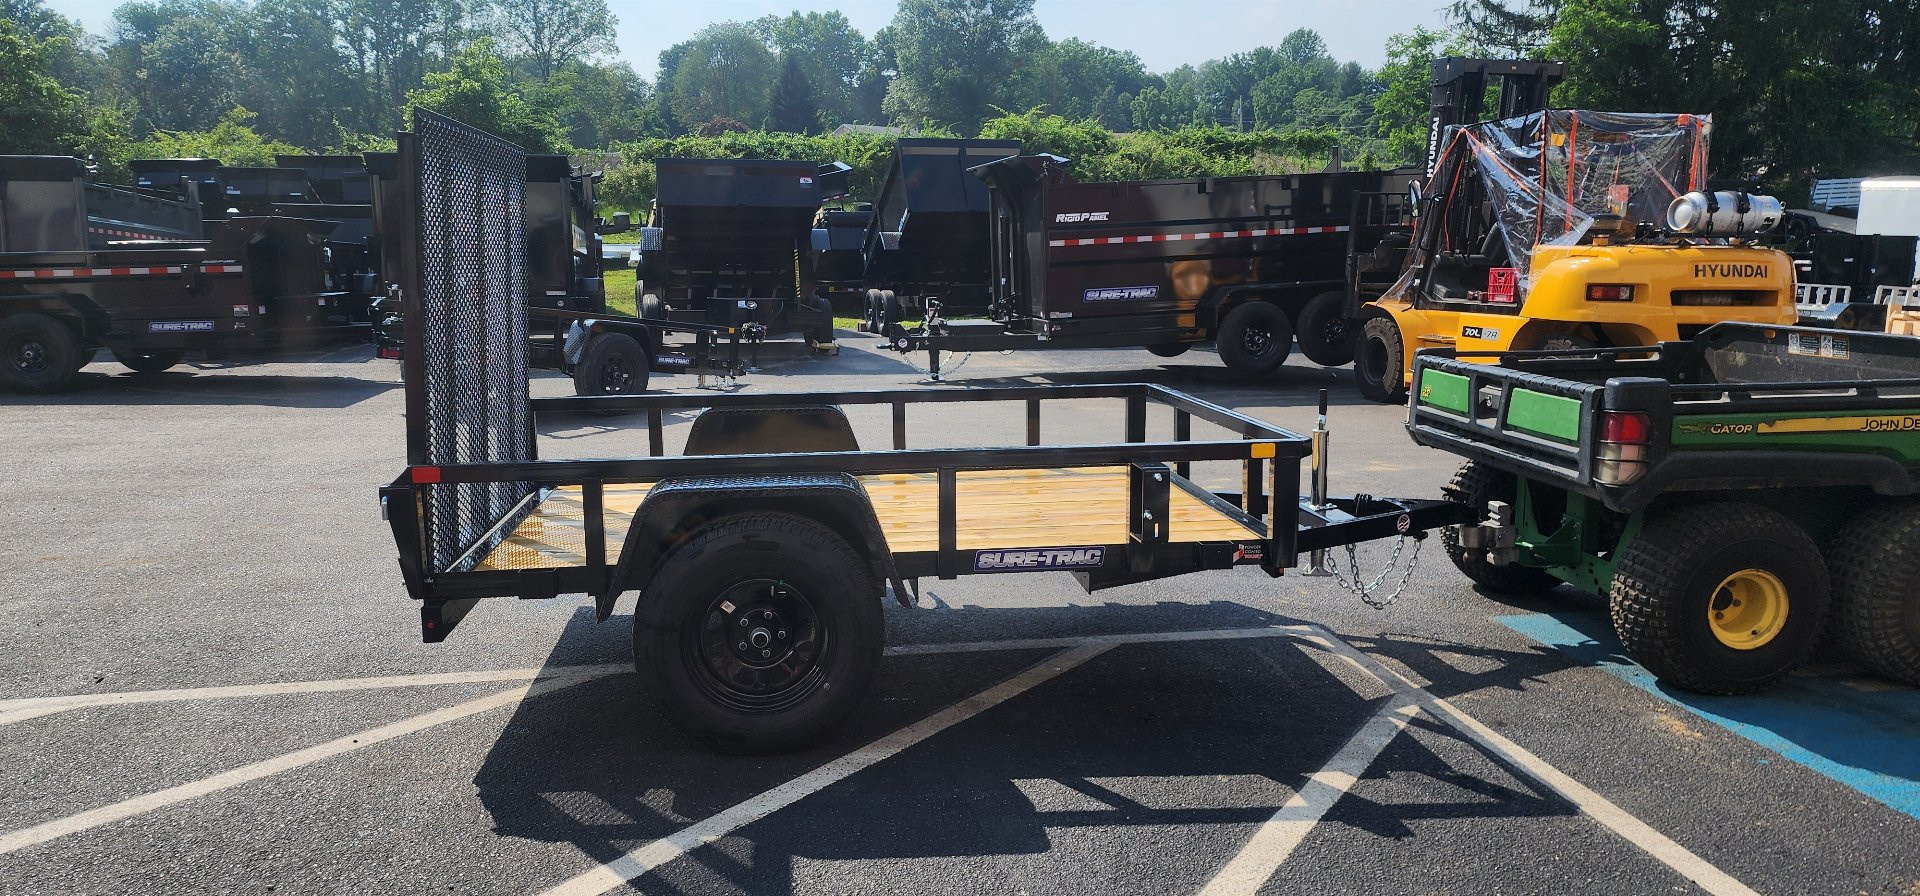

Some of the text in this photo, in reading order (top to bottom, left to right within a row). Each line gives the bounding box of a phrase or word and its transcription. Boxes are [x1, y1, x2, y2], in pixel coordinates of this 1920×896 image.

[1427, 117, 1440, 178] HYUNDAI
[1694, 264, 1768, 278] HYUNDAI
[1086, 288, 1156, 300] SURE-TRAC
[151, 322, 212, 331] SURE-TRAC
[1711, 423, 1753, 434] GATOR
[1861, 418, 1900, 430] JOHN
[978, 550, 1101, 567] SURE-TRAC
